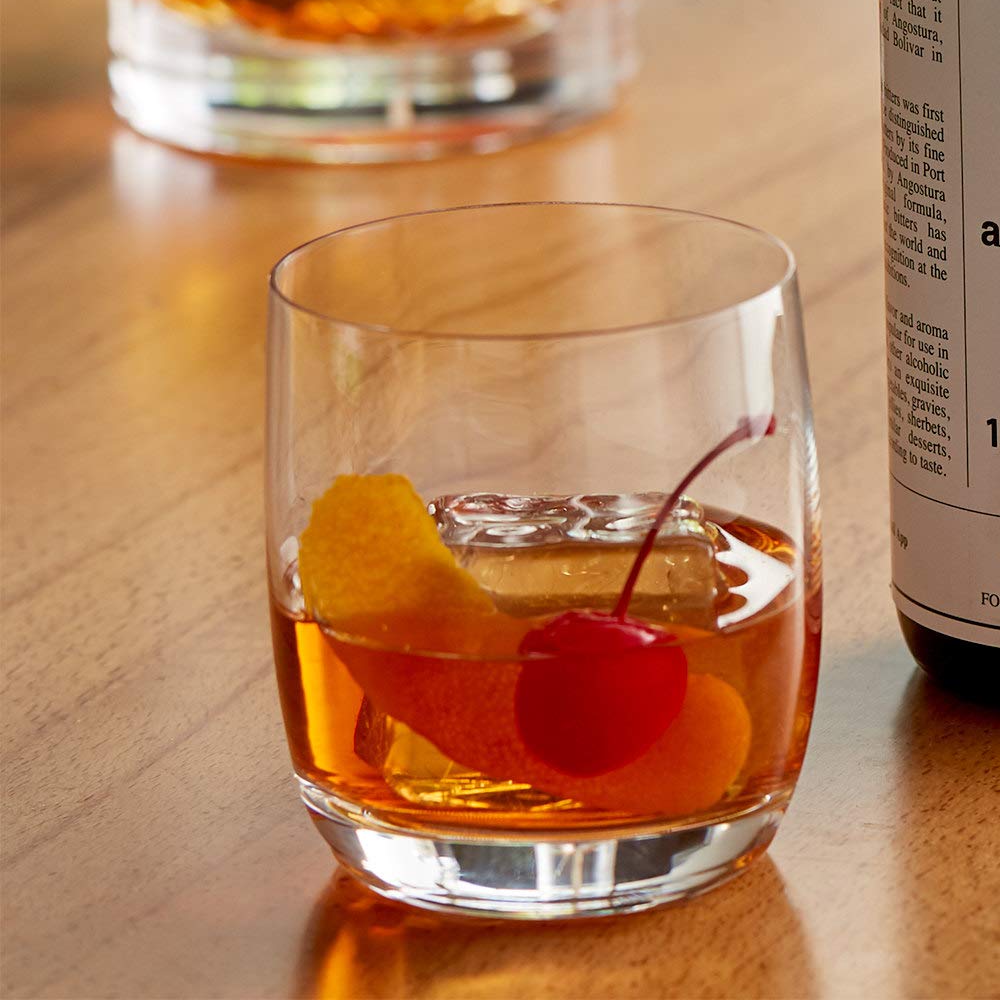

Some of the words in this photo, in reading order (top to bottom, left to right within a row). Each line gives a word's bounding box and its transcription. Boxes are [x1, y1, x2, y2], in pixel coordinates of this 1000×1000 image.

[908, 0, 926, 19] that
[934, 7, 943, 23] it
[892, 12, 943, 45] Angostura,
[893, 30, 925, 58] Bolivar
[932, 46, 943, 63] in
[888, 107, 945, 143] distinguished
[902, 99, 919, 115] was
[922, 103, 945, 123] first
[896, 131, 906, 151] by
[908, 137, 919, 155] its
[924, 143, 945, 163] fine
[910, 157, 920, 175] in
[923, 162, 946, 182] Port
[897, 172, 946, 203] Angostura
[893, 206, 918, 233] bitters
[927, 222, 947, 242] has
[903, 194, 947, 225] formula,
[899, 234, 924, 255] world
[927, 246, 947, 261] and
[917, 262, 927, 275] at
[930, 263, 948, 281] the
[900, 312, 914, 328] and
[916, 320, 949, 341] aroma
[903, 330, 916, 348] for
[918, 340, 935, 356] use
[938, 343, 949, 360] in
[905, 352, 949, 380] alcoholic
[905, 373, 949, 399] exquisite
[911, 396, 951, 422] gravies,
[907, 411, 951, 441] sherbets,
[908, 430, 951, 461] desserts,
[910, 451, 918, 466] to
[920, 457, 947, 477] taste.
